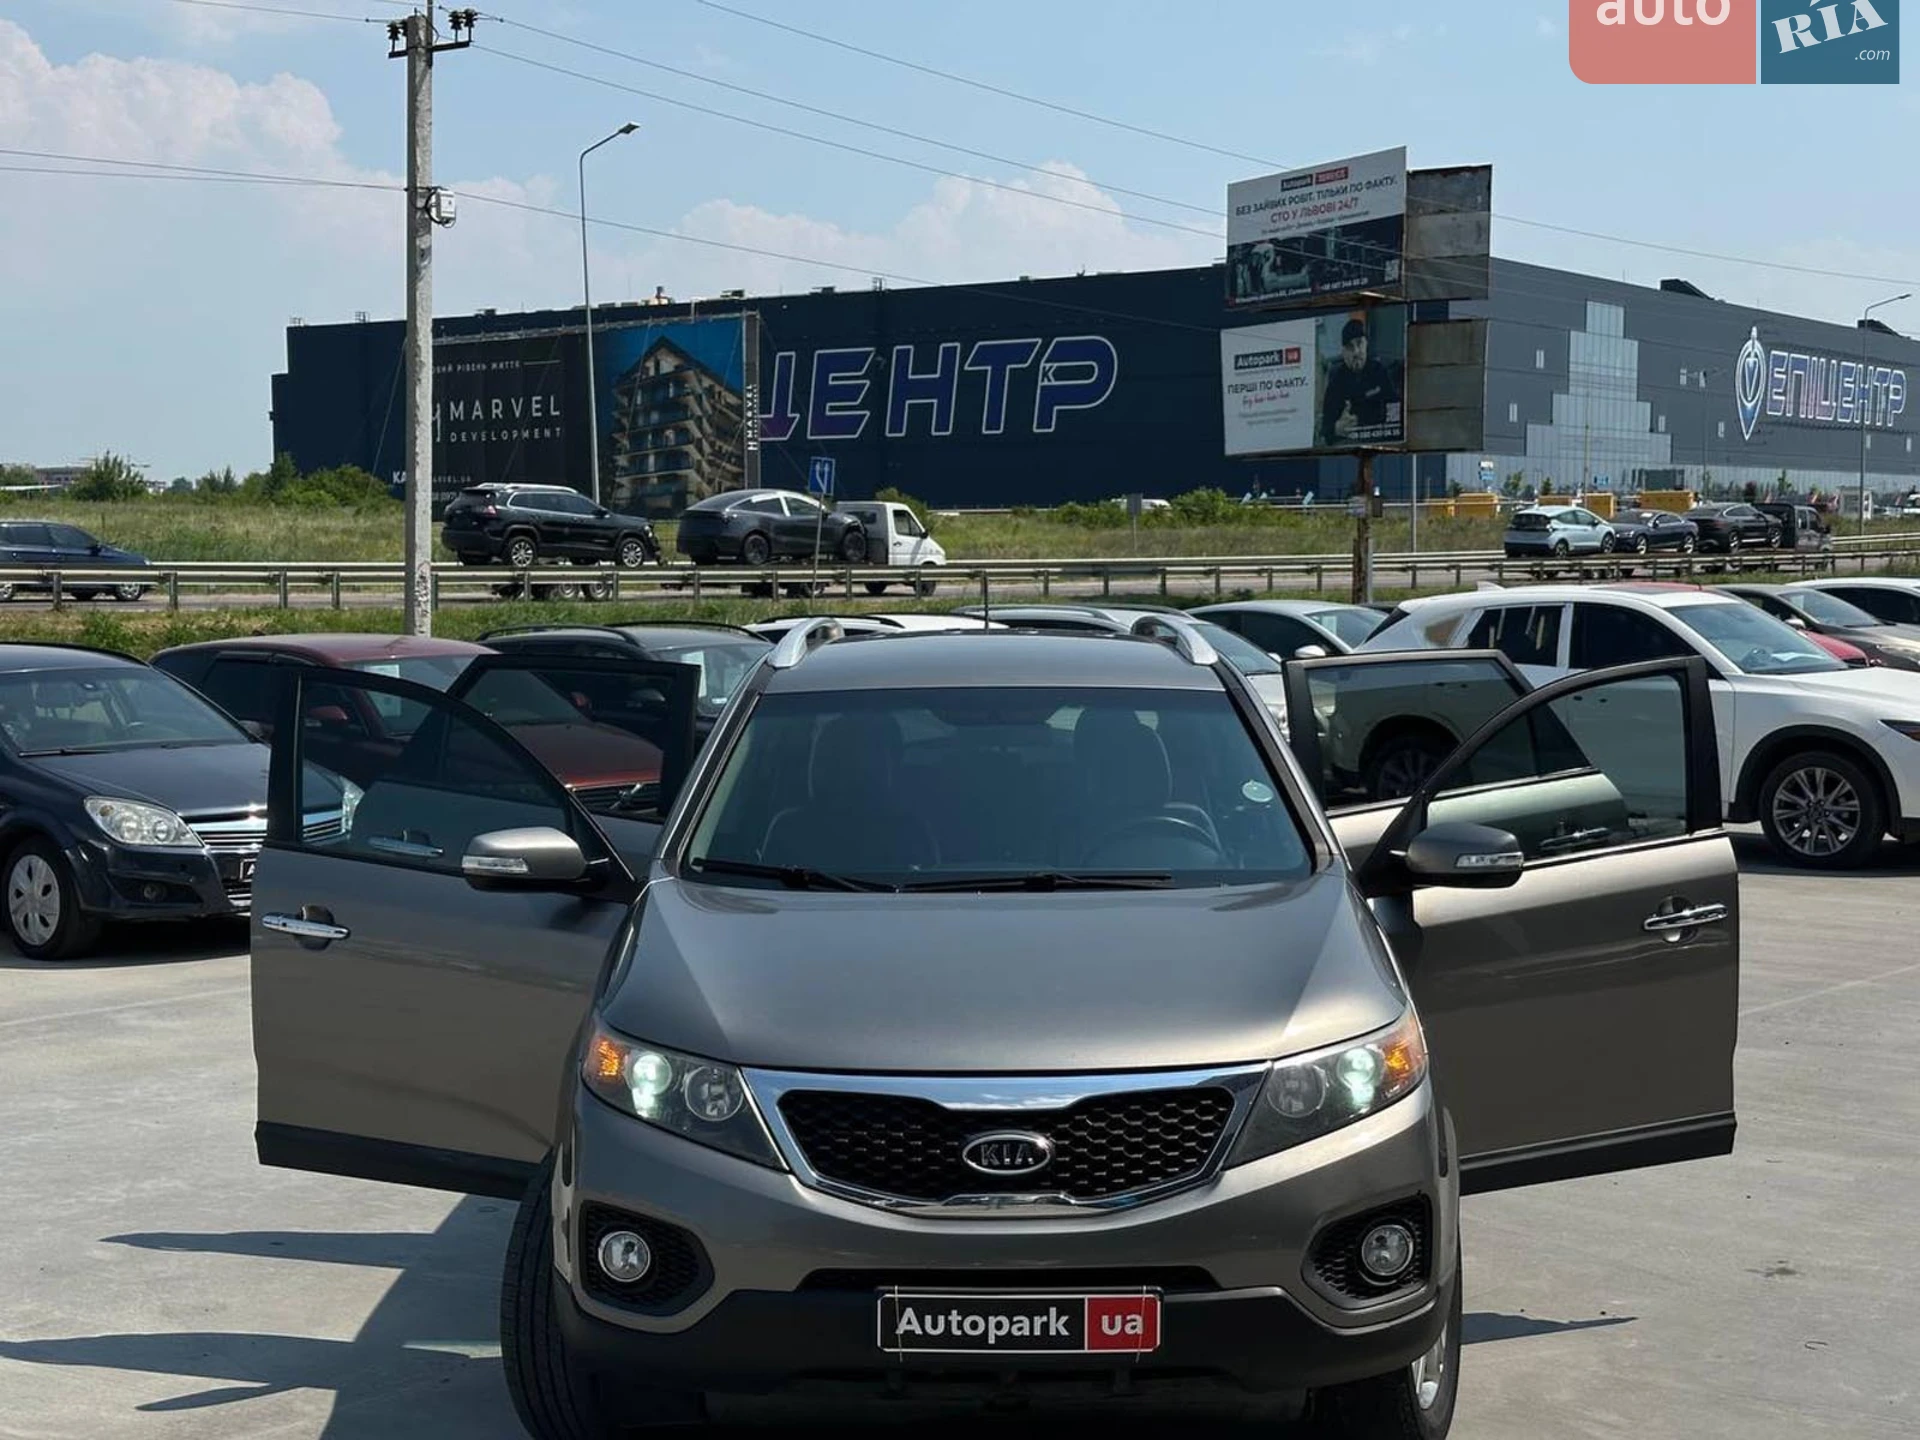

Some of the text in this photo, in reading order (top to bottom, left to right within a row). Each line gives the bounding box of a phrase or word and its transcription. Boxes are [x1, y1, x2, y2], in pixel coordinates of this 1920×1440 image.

[1235, 204, 1250, 216] БЕЗ
[1350, 182, 1364, 193] ПО
[1270, 210, 1290, 223] СТО
[1299, 203, 1337, 217] ЛЬВОВІ
[1337, 197, 1359, 211] 24/7
[1236, 352, 1280, 367] Autopark
[1227, 376, 1309, 394] ПЕРШІ ПО ФАКТУ.
[1765, 349, 1907, 428] ЕПІЦЕНТР
[450, 395, 561, 421] MARVEL
[450, 427, 562, 443] DEVELOPMENT
[980, 1144, 1034, 1166] KIA
[895, 1306, 1144, 1345] Autopark ua
